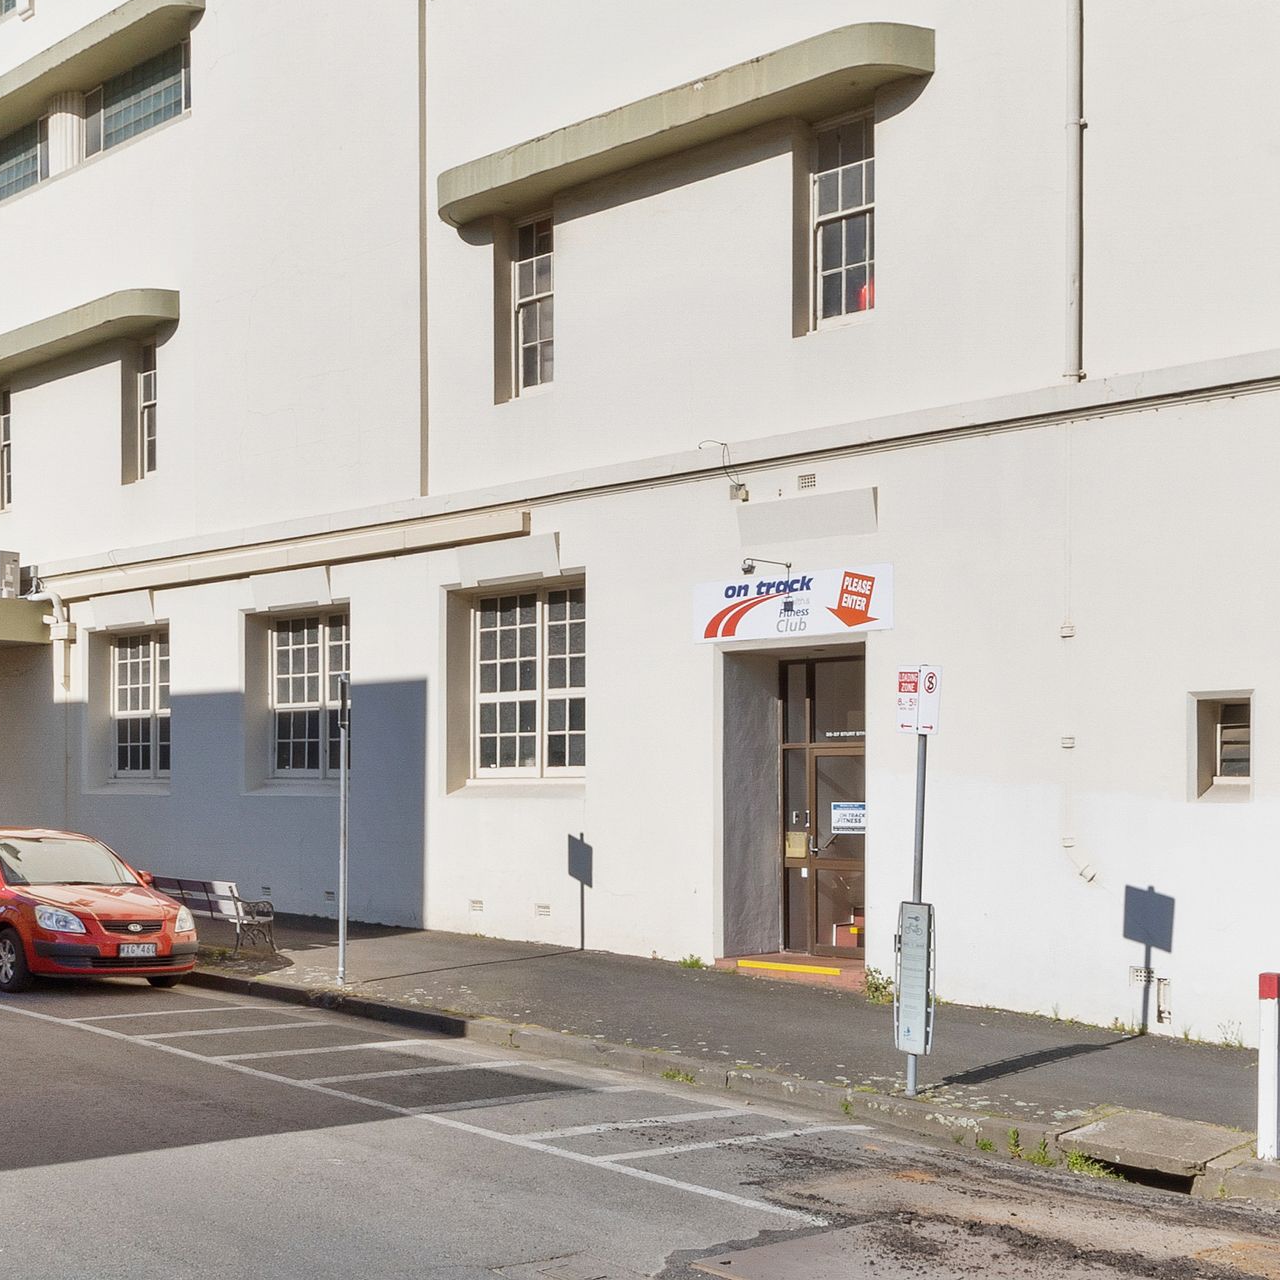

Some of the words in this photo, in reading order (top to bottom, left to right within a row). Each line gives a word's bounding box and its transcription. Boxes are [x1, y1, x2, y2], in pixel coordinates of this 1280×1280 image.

[724, 583, 749, 598] on
[756, 576, 813, 595] track
[843, 577, 872, 594] PLEASE
[841, 594, 866, 610] ENTER
[776, 617, 807, 633] Club
